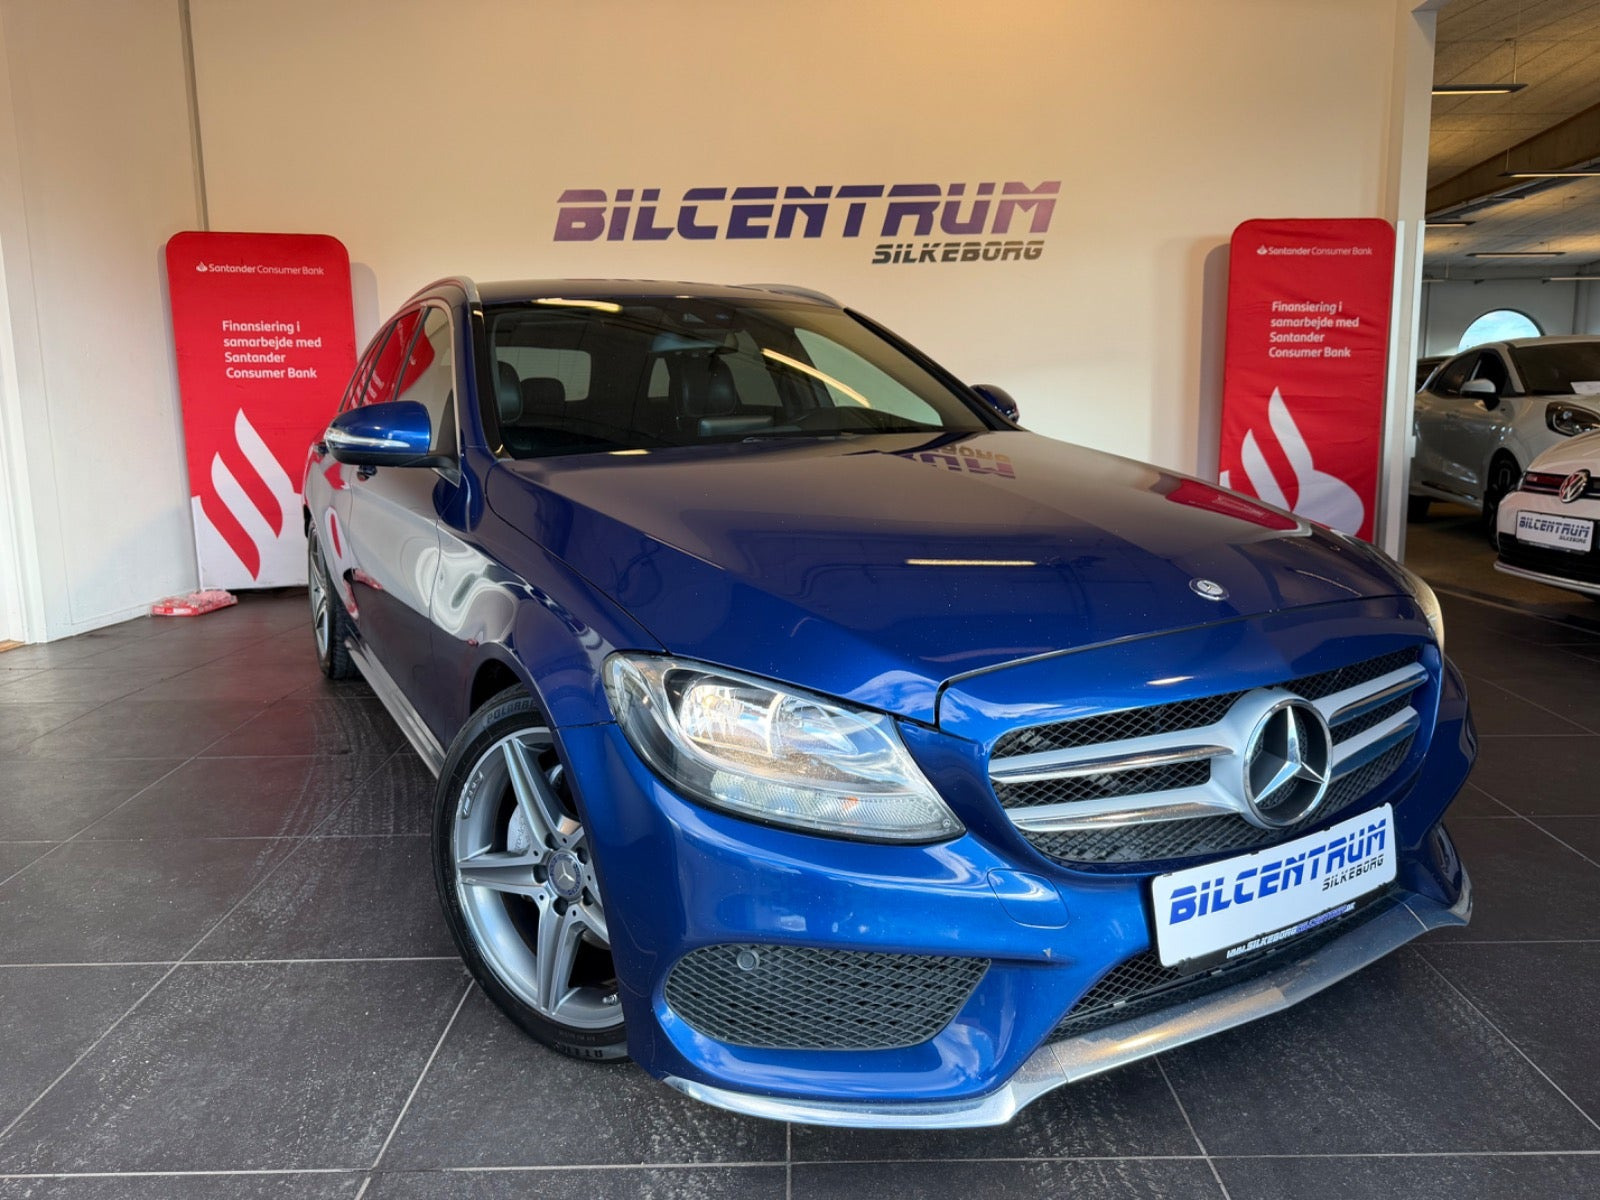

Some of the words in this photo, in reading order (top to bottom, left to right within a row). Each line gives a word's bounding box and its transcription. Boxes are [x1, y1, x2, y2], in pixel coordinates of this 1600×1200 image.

[552, 180, 1062, 242] BILCENTRUM
[871, 239, 1045, 265] SILKEBORG
[1268, 246, 1311, 256] Santander
[1311, 247, 1351, 256] Consumer
[1352, 247, 1373, 256] Bank
[208, 263, 256, 274] Santander
[257, 264, 301, 275] Consumer
[302, 266, 325, 276] Bank
[1271, 300, 1337, 315] Finansiering
[1338, 301, 1343, 312] i
[222, 320, 295, 335] Finansiering
[296, 321, 301, 333] i
[1270, 316, 1333, 330] samarbejde
[1335, 316, 1360, 328] med
[223, 336, 294, 350] samarbejde
[295, 337, 322, 348] med
[1269, 331, 1325, 343] Santander
[224, 351, 286, 363] Santander
[1268, 346, 1322, 358] Consumer
[1323, 347, 1352, 358] Bank
[225, 367, 285, 379] Consumer
[287, 367, 318, 379] Bank
[1519, 516, 1591, 539] BILCENTRUM
[1168, 818, 1387, 925] BILCENTRUM
[1321, 853, 1385, 892] SILKEBORG
